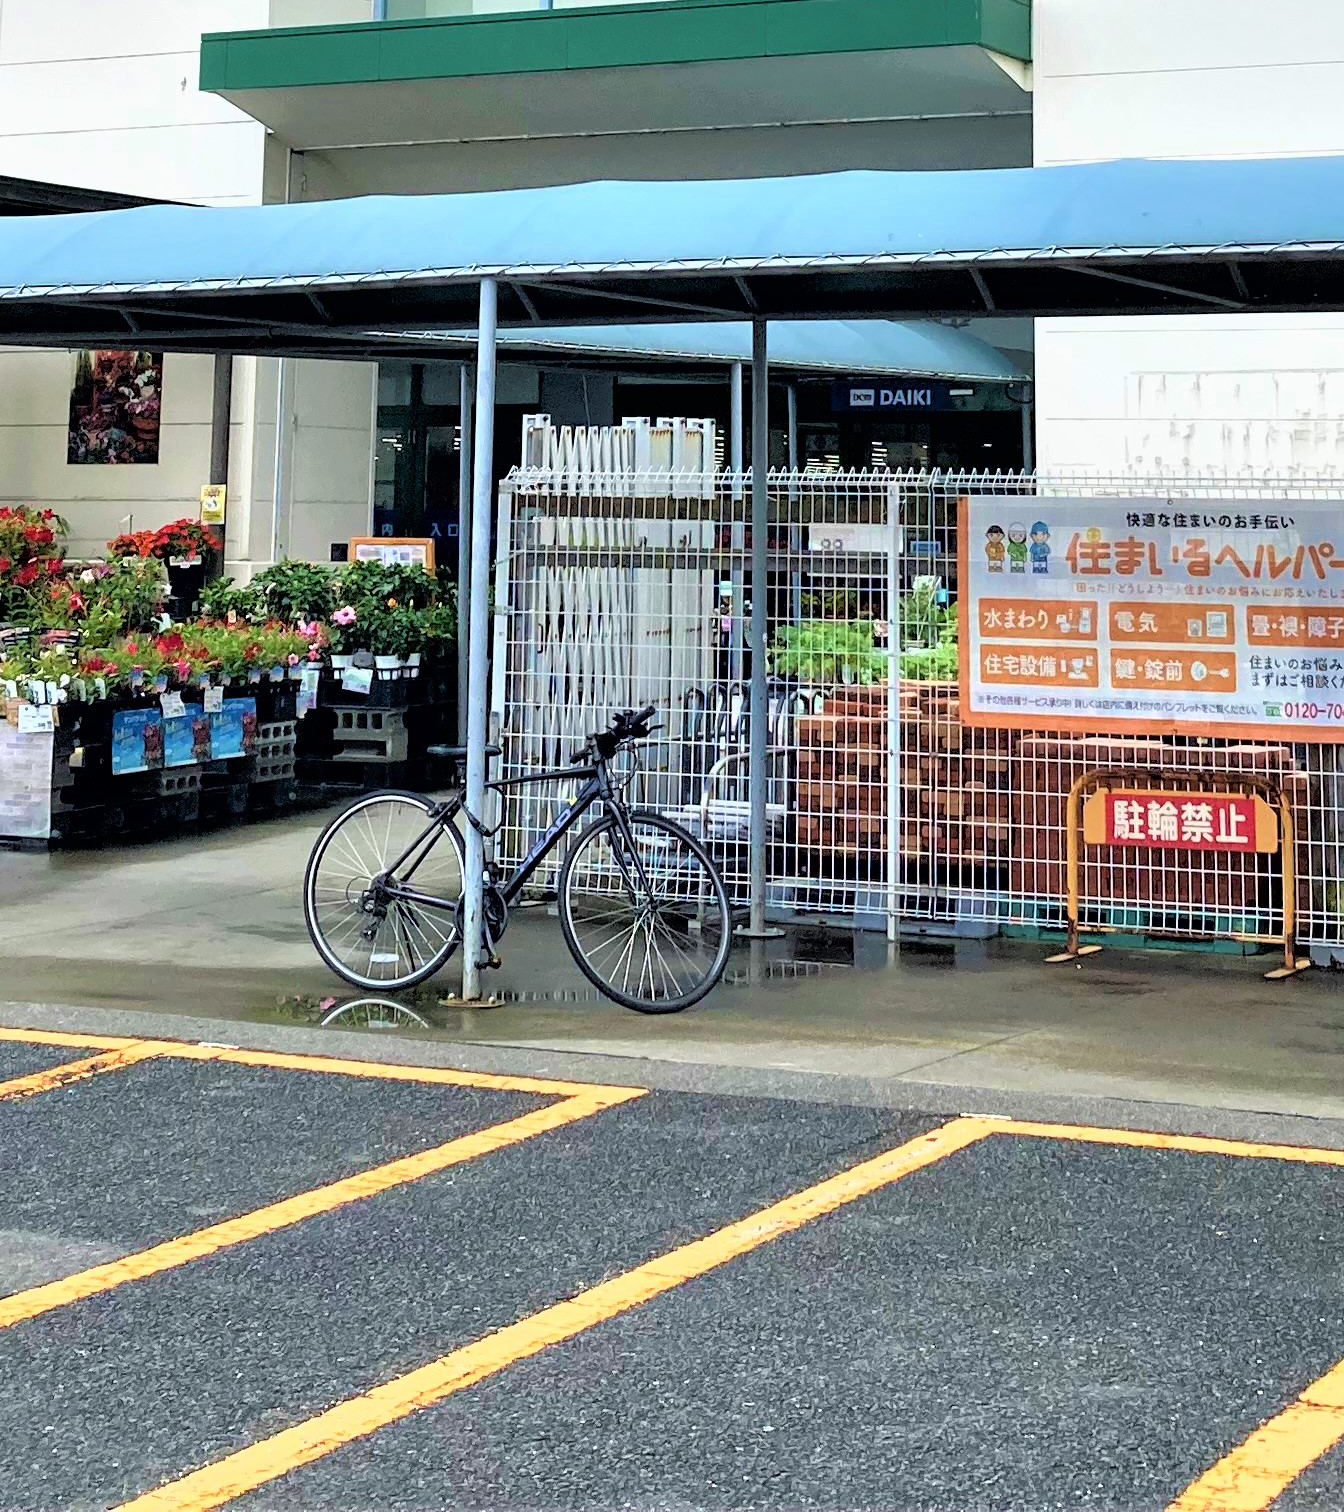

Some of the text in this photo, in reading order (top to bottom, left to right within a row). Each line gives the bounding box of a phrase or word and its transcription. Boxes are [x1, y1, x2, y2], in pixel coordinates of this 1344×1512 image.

[879, 389, 931, 406] DAIKI
[1126, 512, 1295, 529] 快適な住まいのお手伝い
[983, 607, 1049, 630] 水まわり
[1114, 610, 1158, 633] 電気
[984, 653, 1057, 677] 住宅設備
[1114, 658, 1183, 681] 鍵・錠前
[1249, 654, 1343, 671] 住まいのお悩み
[1111, 798, 1250, 846] 駐輪禁止
